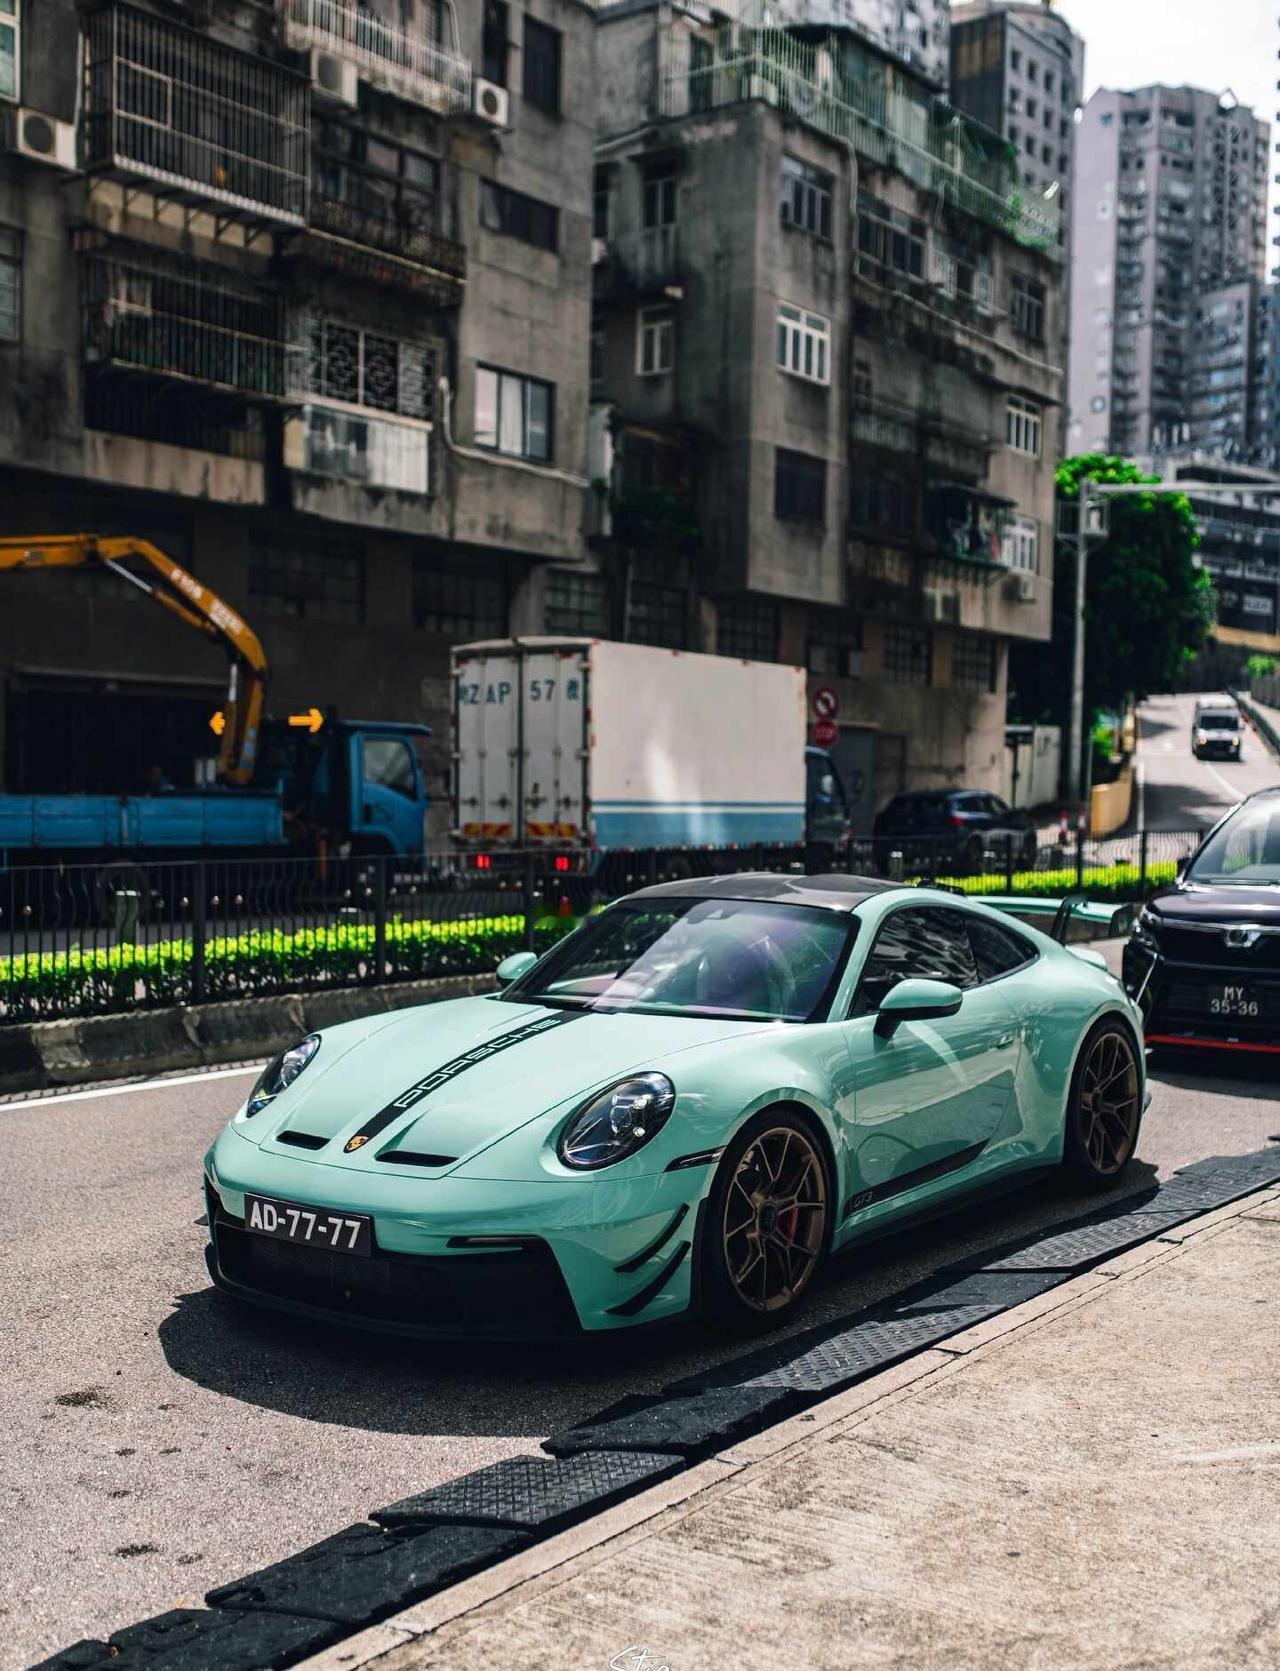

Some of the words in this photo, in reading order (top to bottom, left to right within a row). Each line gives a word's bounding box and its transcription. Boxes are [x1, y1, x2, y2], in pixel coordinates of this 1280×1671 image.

[1210, 998, 1259, 1017] 35-36
[1223, 986, 1244, 1001] MY
[393, 1018, 562, 1108] PORSCHE
[250, 1201, 361, 1249] AD-77-77
